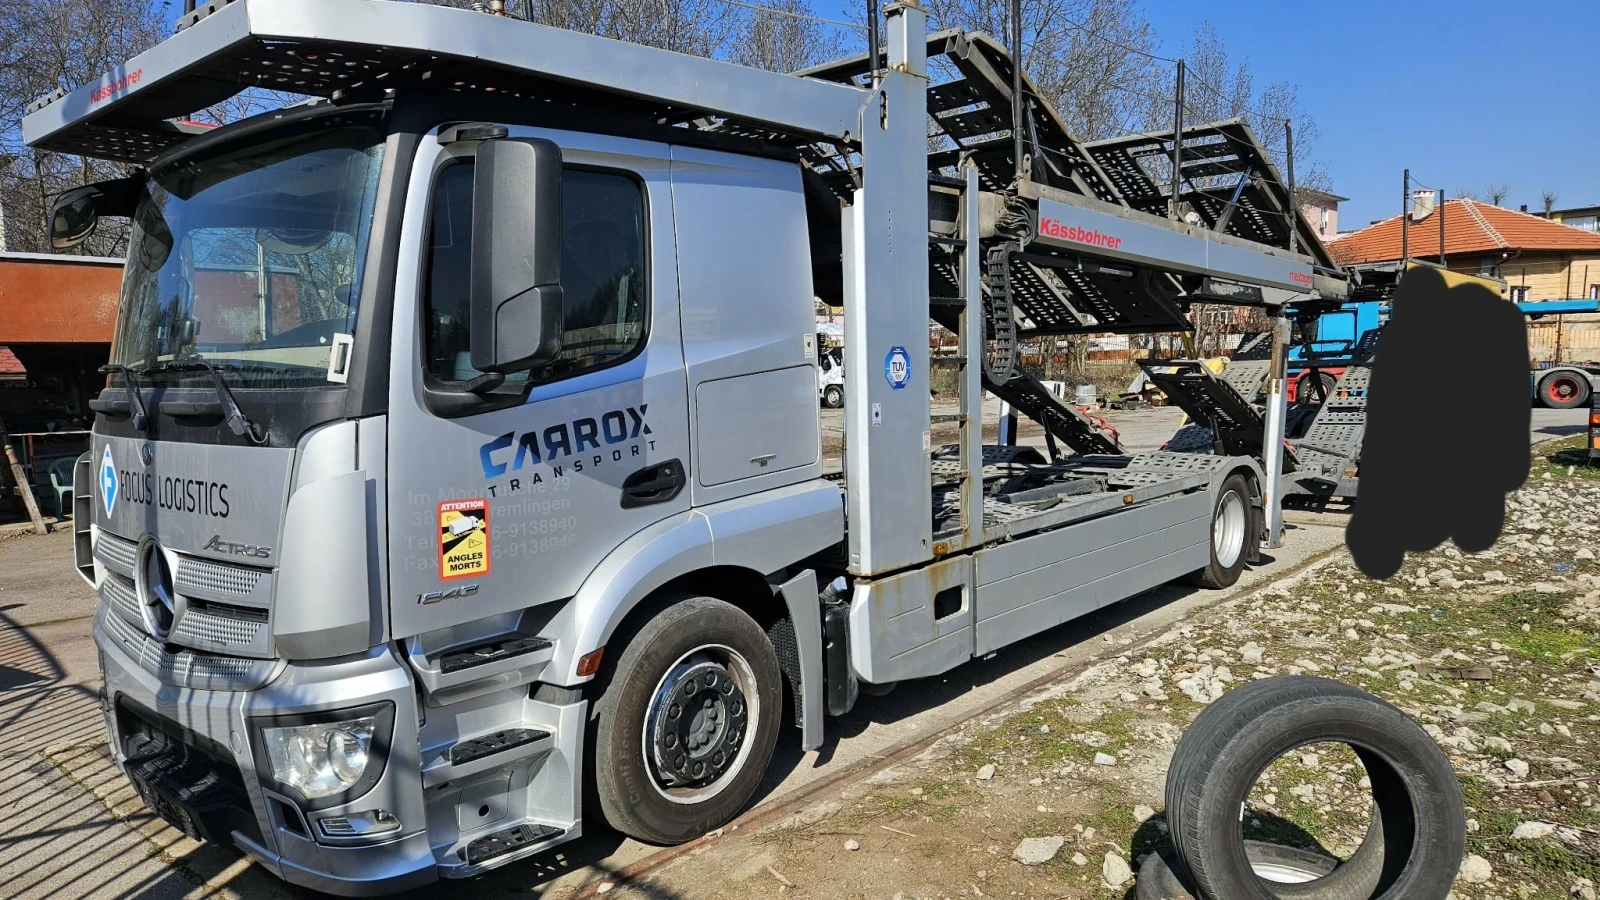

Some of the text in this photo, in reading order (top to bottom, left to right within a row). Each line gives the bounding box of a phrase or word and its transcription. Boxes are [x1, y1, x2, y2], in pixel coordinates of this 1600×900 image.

[90, 68, 142, 104] Kässbohrer
[1040, 217, 1121, 248] Kässbohrer
[479, 404, 652, 480] CARROX
[488, 440, 656, 498] TRANSPORT
[120, 470, 230, 518] FOCUS LOGISTICS
[551, 475, 571, 492] 29
[441, 500, 484, 511] ATTENTION
[490, 498, 571, 518] remlingen
[447, 552, 483, 563] ANGLES
[449, 561, 481, 572] MORTS
